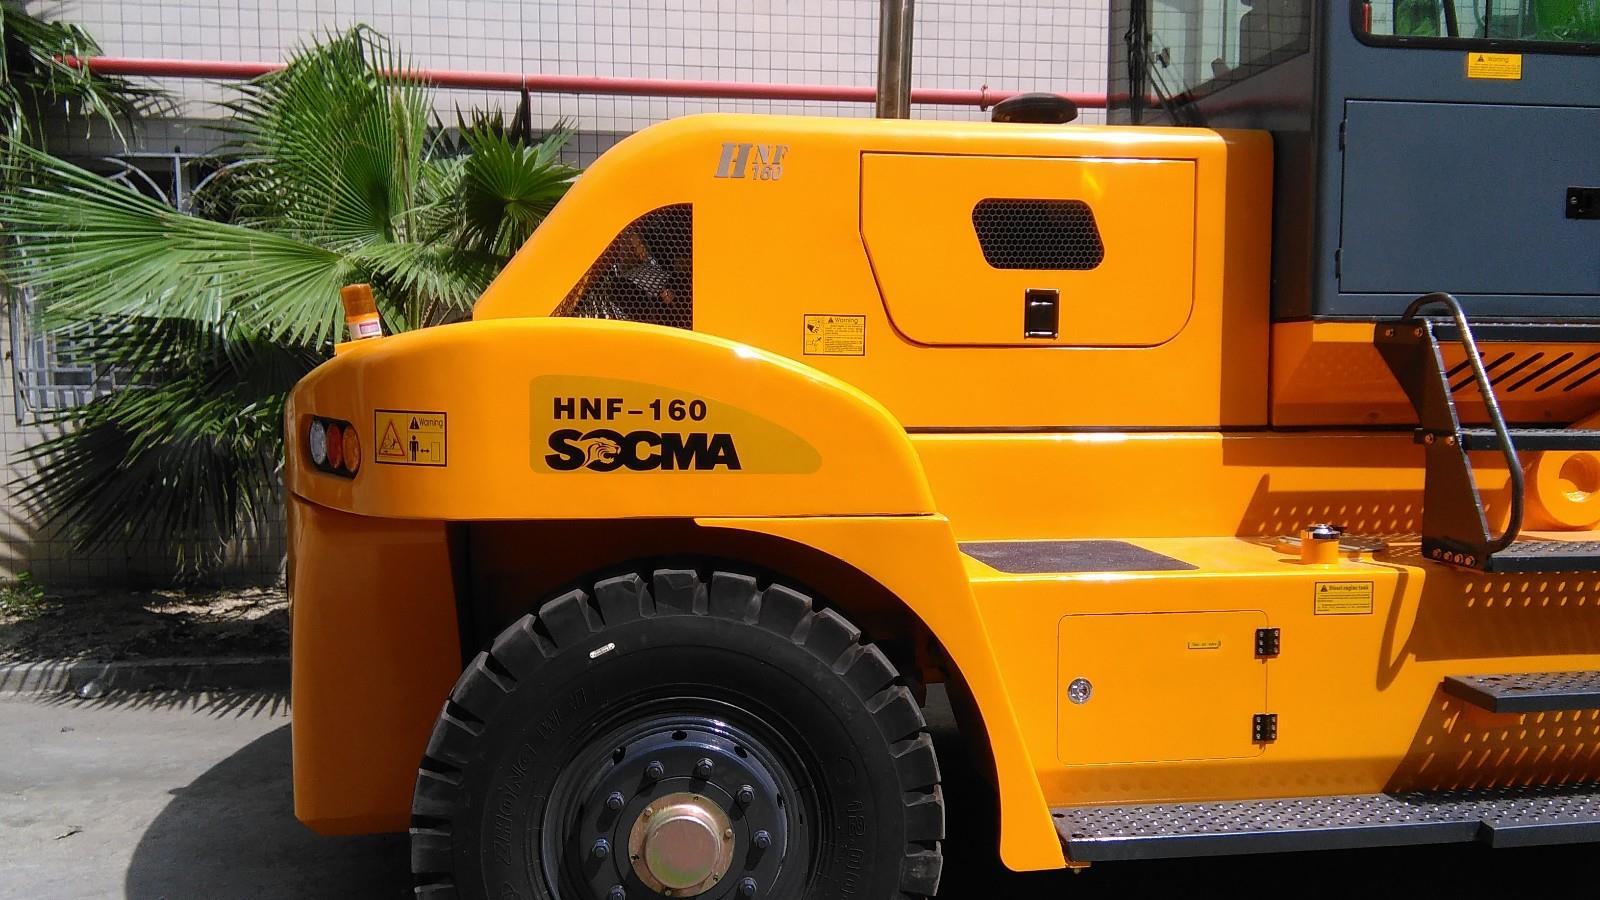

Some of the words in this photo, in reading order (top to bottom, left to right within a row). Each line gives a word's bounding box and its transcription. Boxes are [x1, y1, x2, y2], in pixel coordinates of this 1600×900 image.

[752, 165, 783, 180] 160
[834, 317, 859, 325] Warning
[553, 397, 708, 421] HNF-160
[418, 417, 444, 429] Warning
[545, 428, 742, 472] SOCMA
